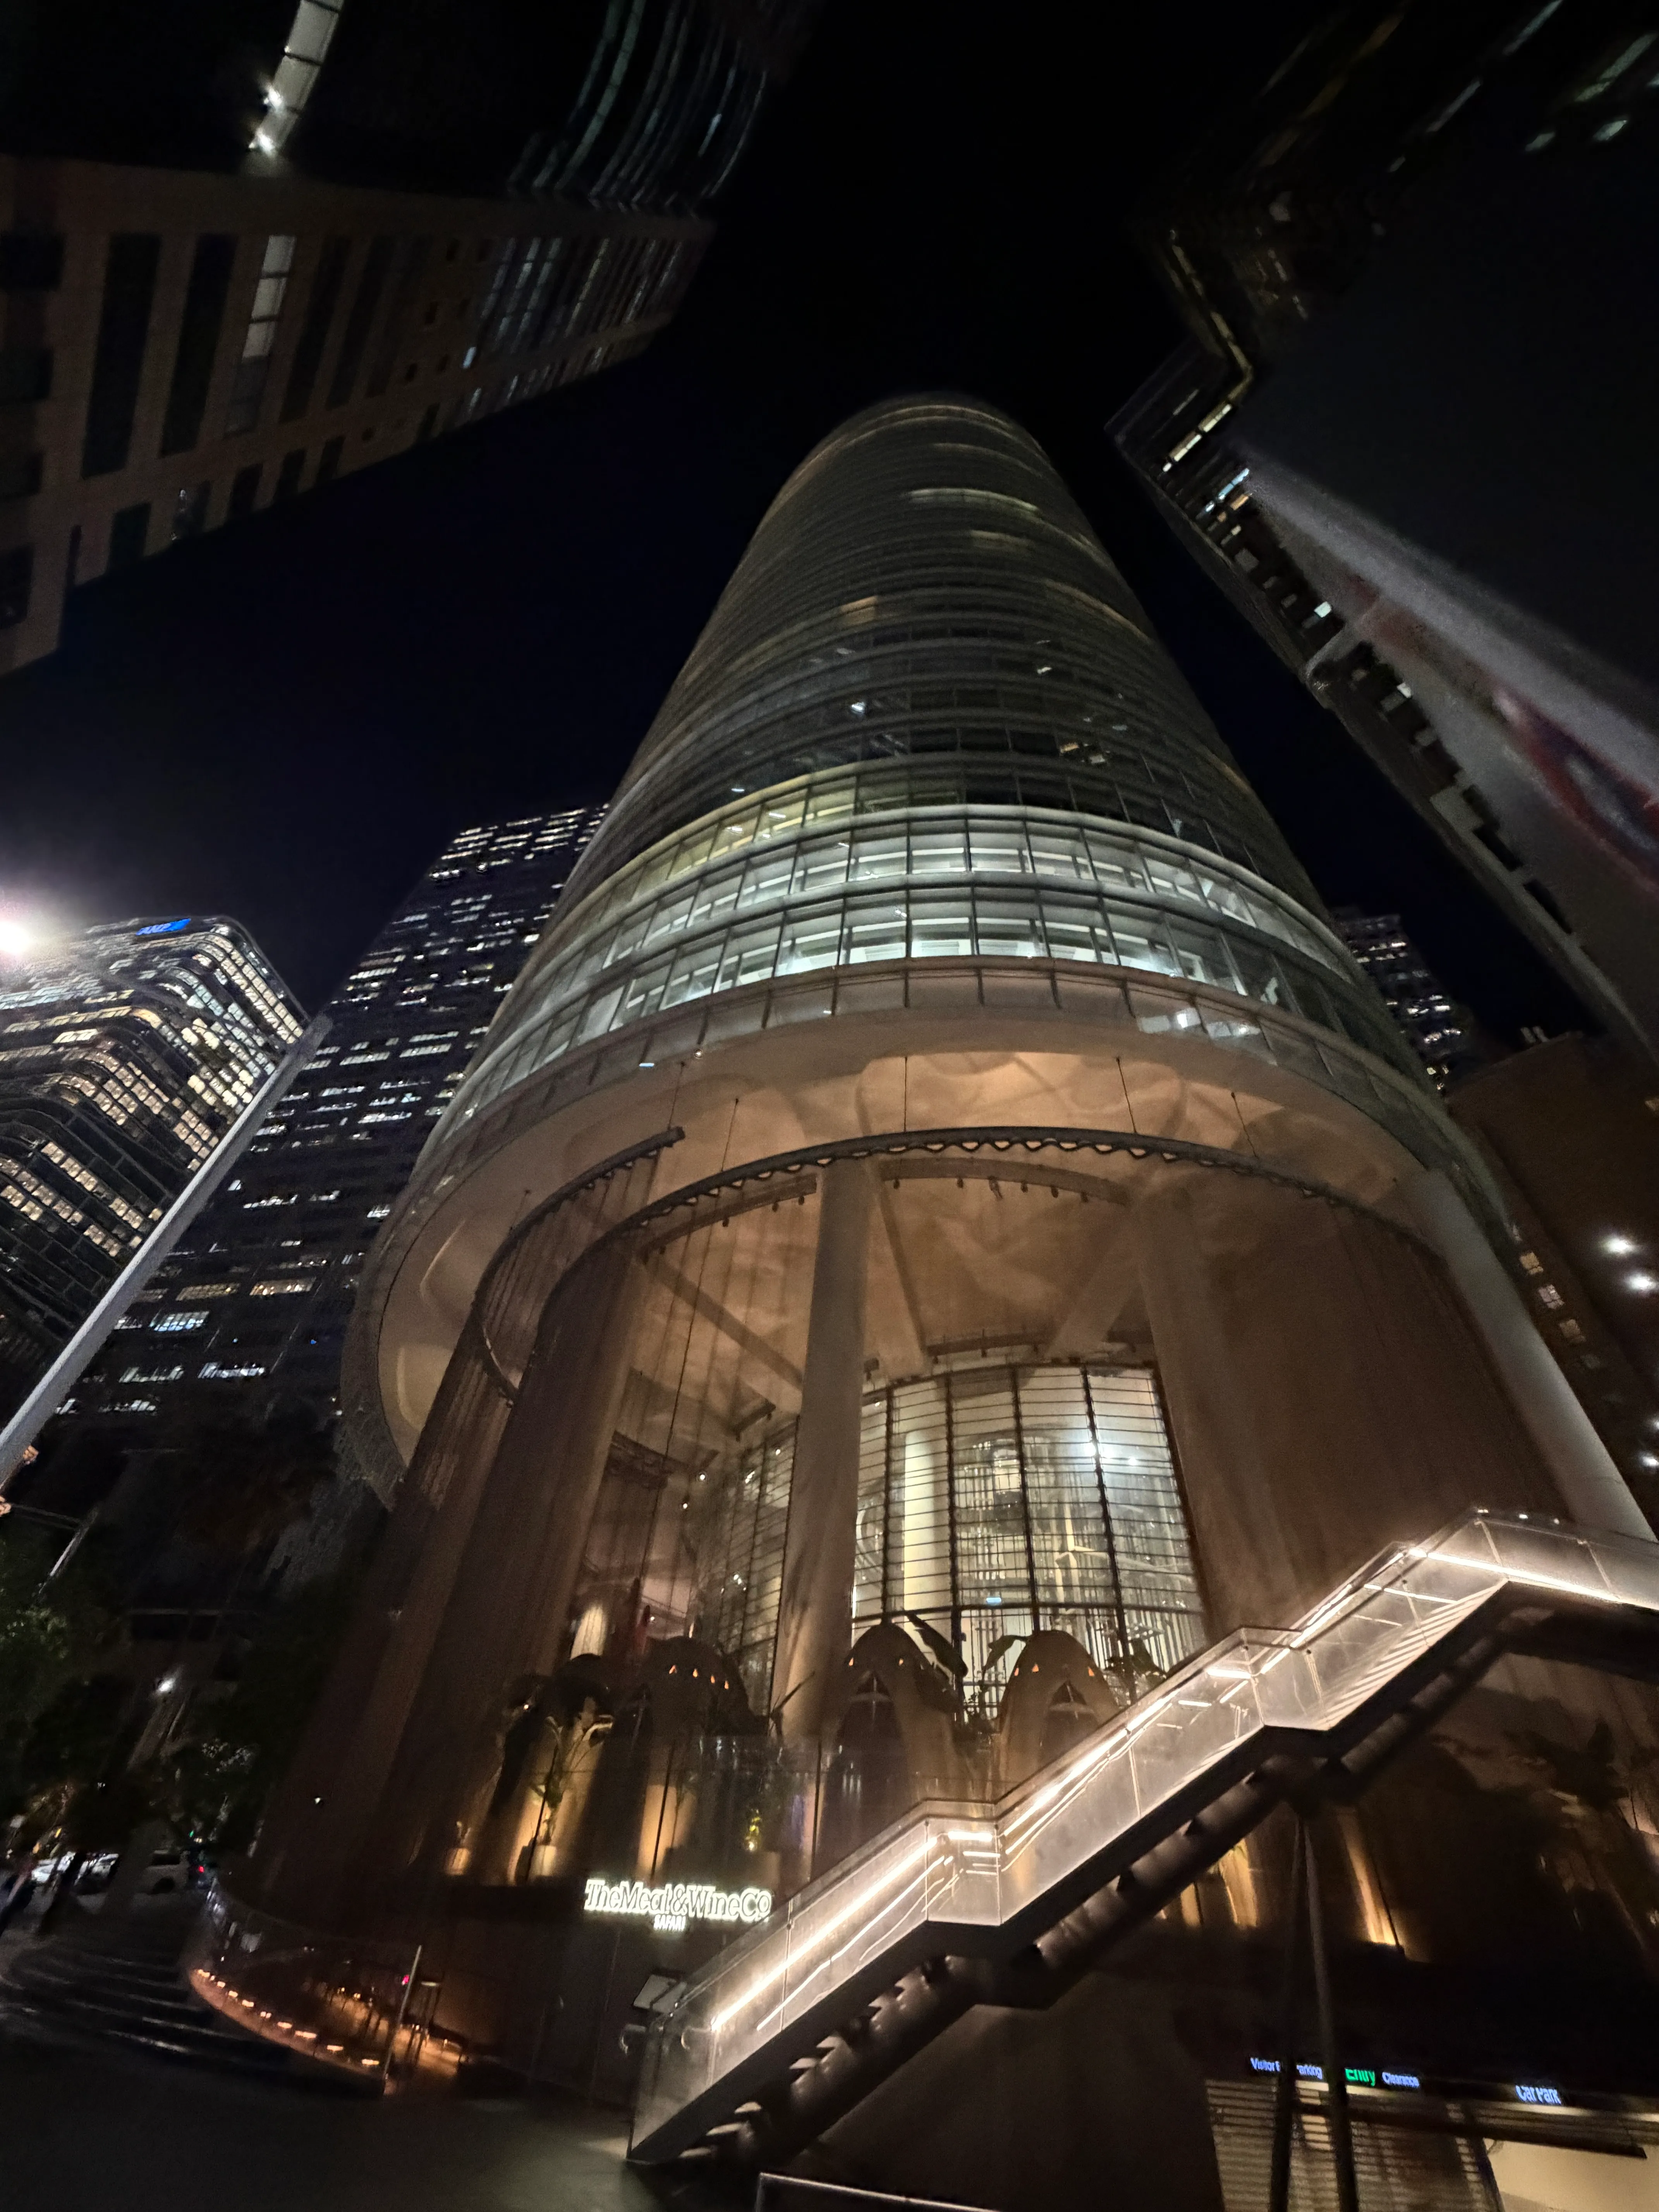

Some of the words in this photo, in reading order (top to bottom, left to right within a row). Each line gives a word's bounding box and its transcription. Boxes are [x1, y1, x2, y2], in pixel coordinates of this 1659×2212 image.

[1296, 2064, 1323, 2080] arking
[1345, 2068, 1375, 2087] Entry
[1515, 2085, 1537, 2103] Car
[1535, 2087, 1561, 2104] Park
